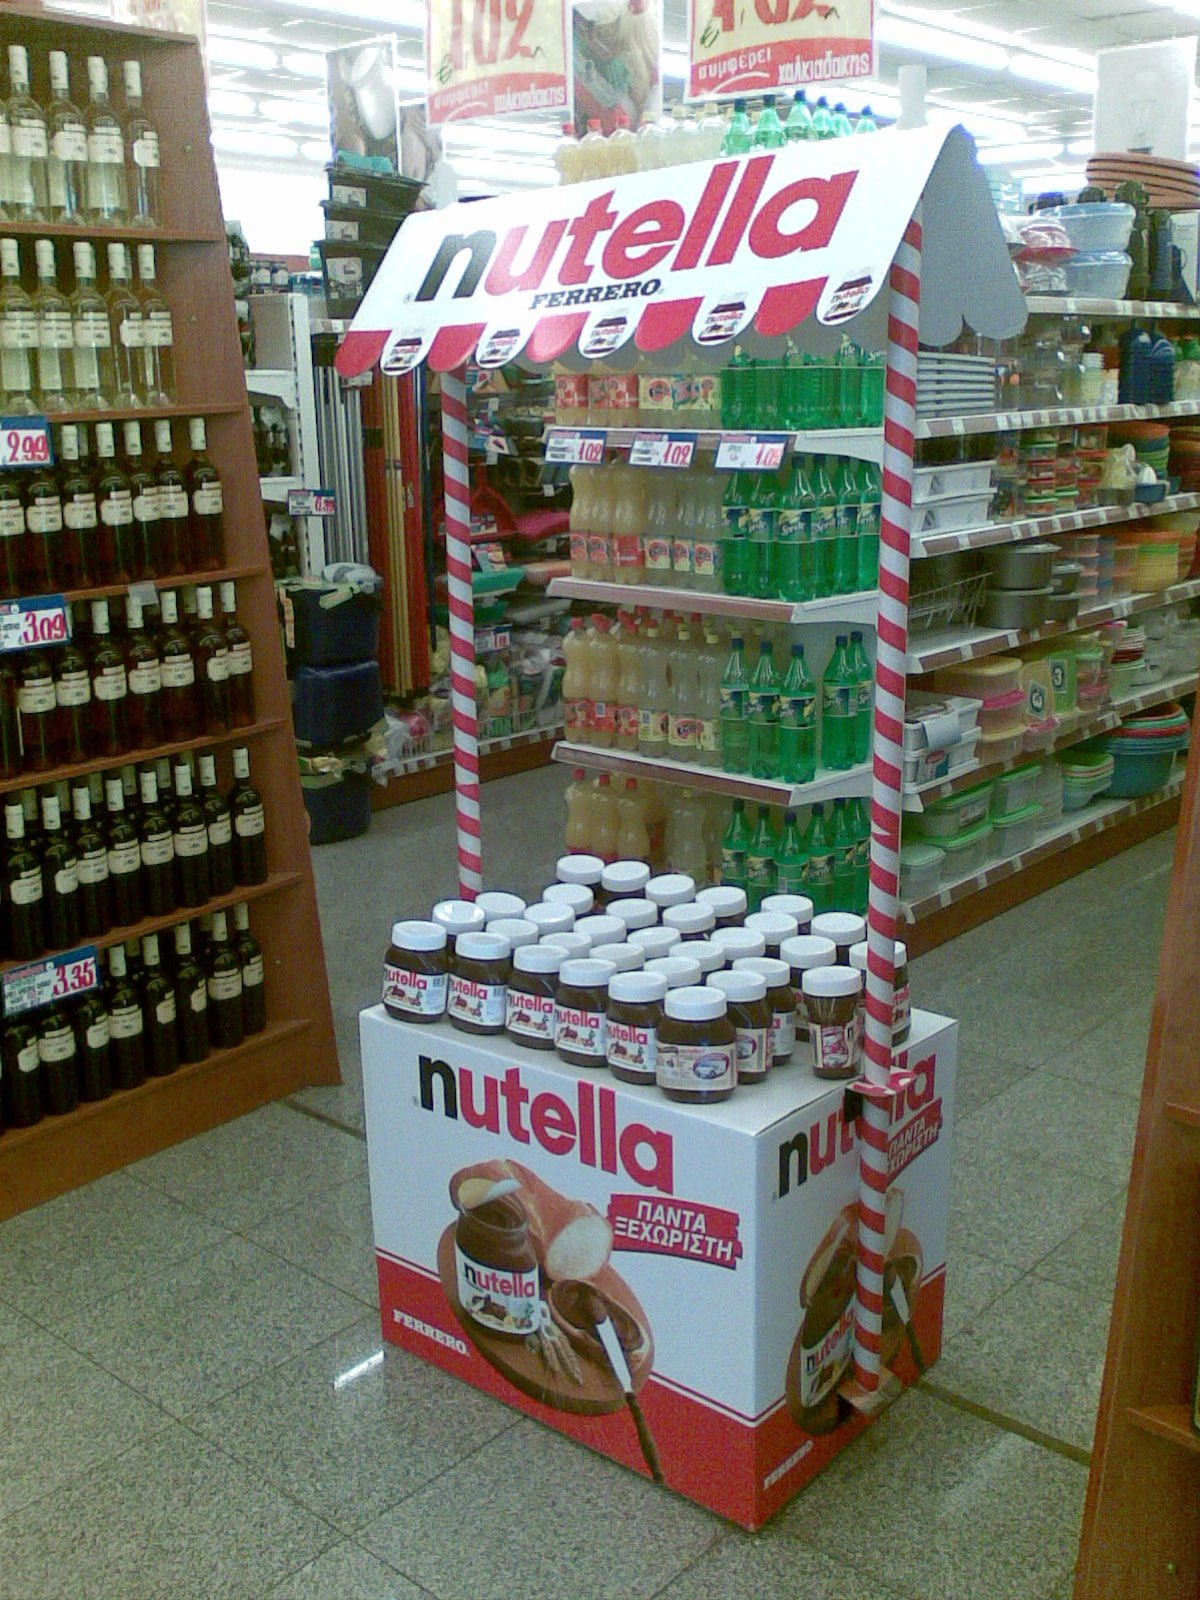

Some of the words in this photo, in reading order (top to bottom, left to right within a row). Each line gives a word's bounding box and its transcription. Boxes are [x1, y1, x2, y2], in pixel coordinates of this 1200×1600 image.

[414, 155, 859, 302] nutella
[529, 279, 661, 309] FERRERO
[419, 1054, 674, 1195] nutella
[614, 1216, 733, 1261] ΞΕΧΩΡΙΣΤΗ
[637, 1200, 707, 1234] ΠΑΝΤΑ
[464, 1262, 536, 1298] nutella
[392, 1308, 468, 1355] FERRERO
